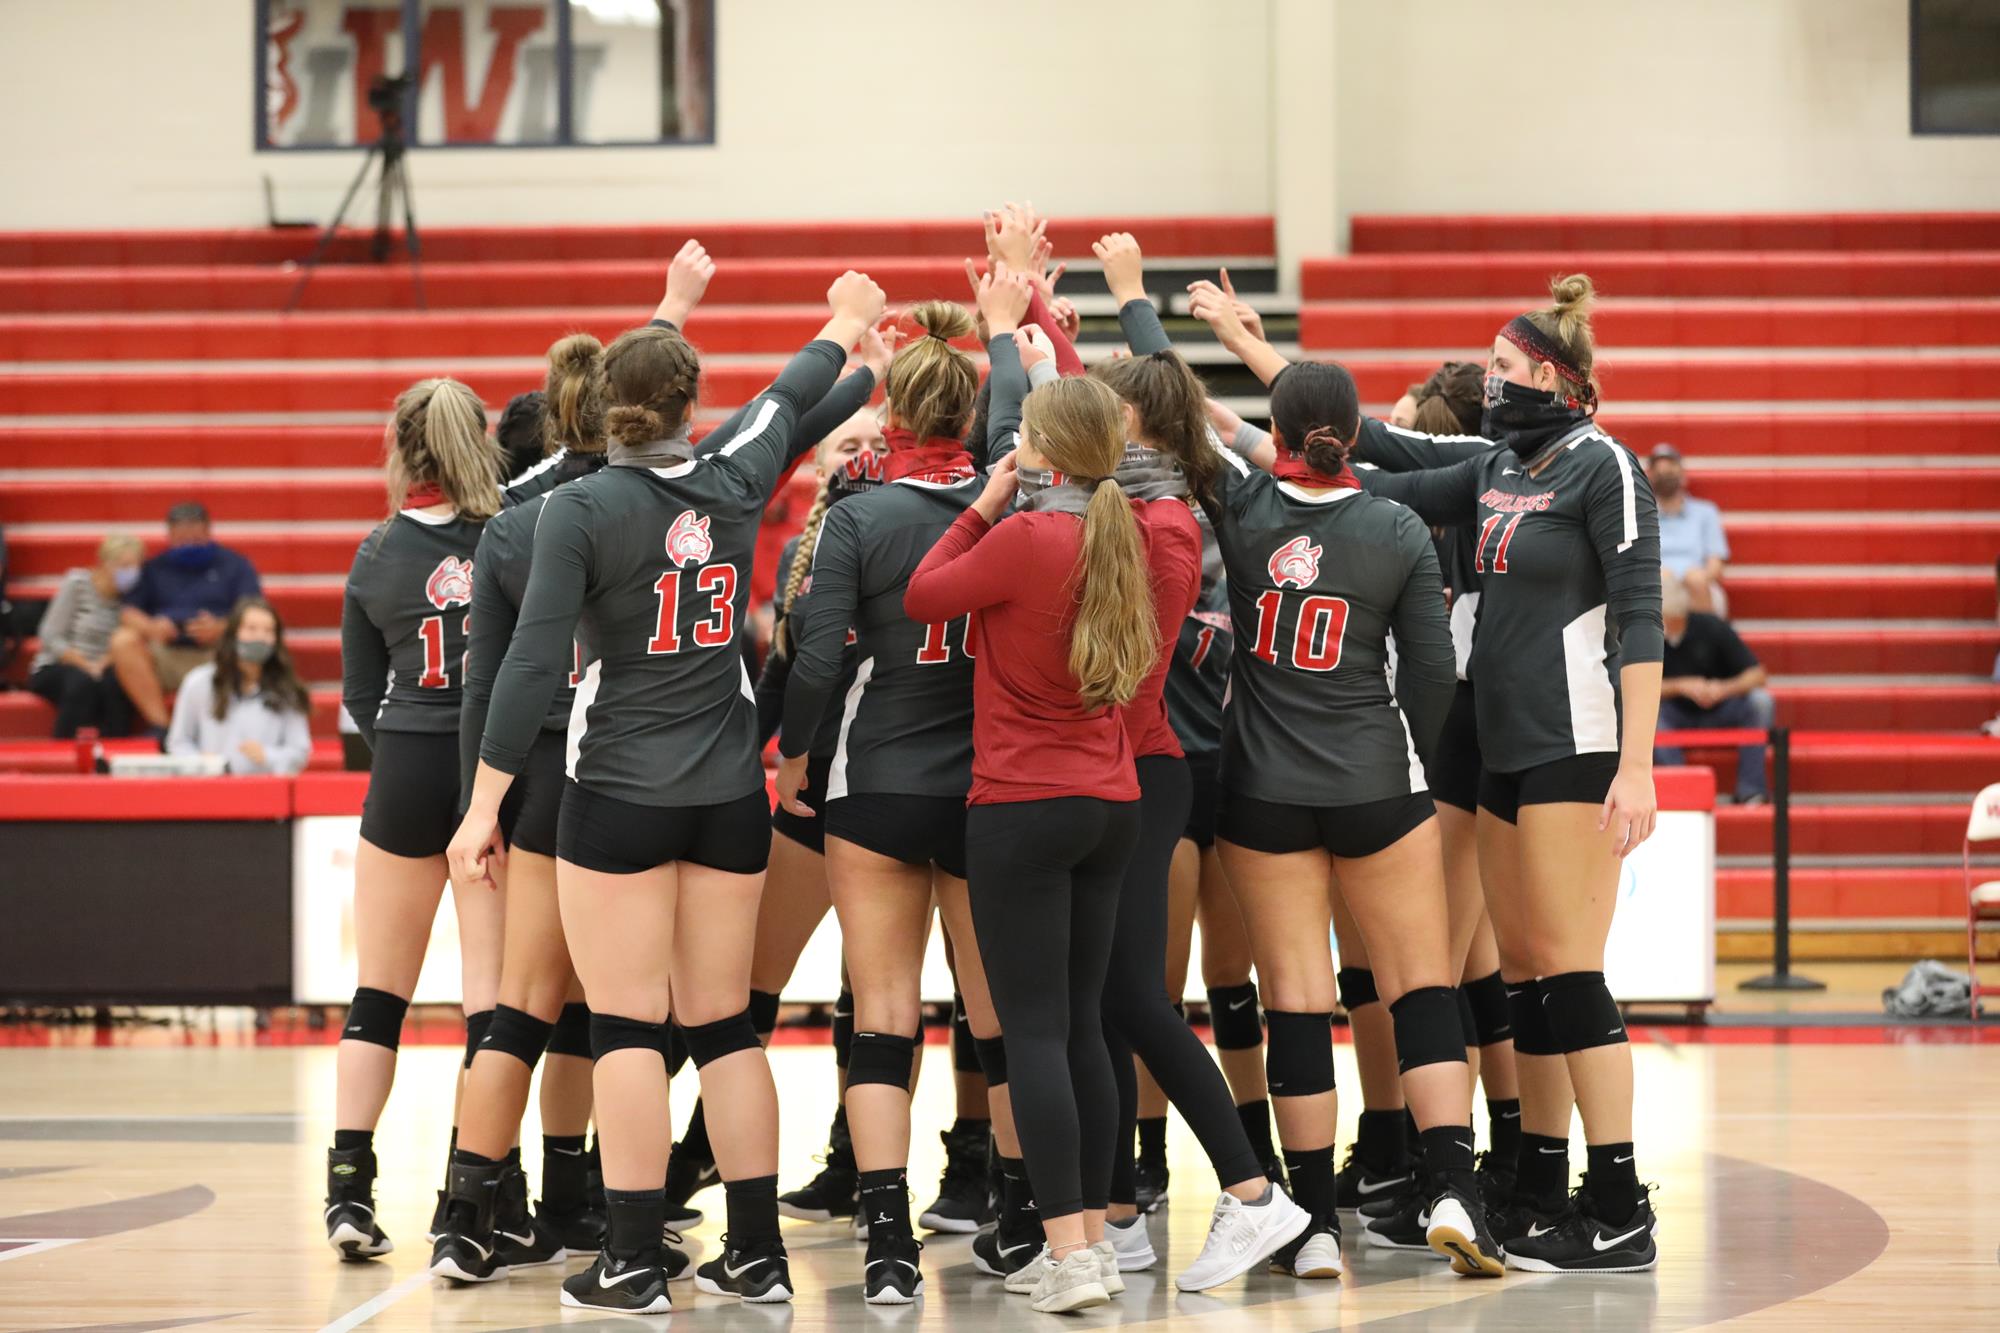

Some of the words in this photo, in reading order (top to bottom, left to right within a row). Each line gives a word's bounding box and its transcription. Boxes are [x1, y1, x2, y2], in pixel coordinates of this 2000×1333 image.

[1475, 512, 1525, 574] 11
[648, 563, 737, 654] 13
[1250, 590, 1350, 672] 10
[418, 615, 471, 689] 1
